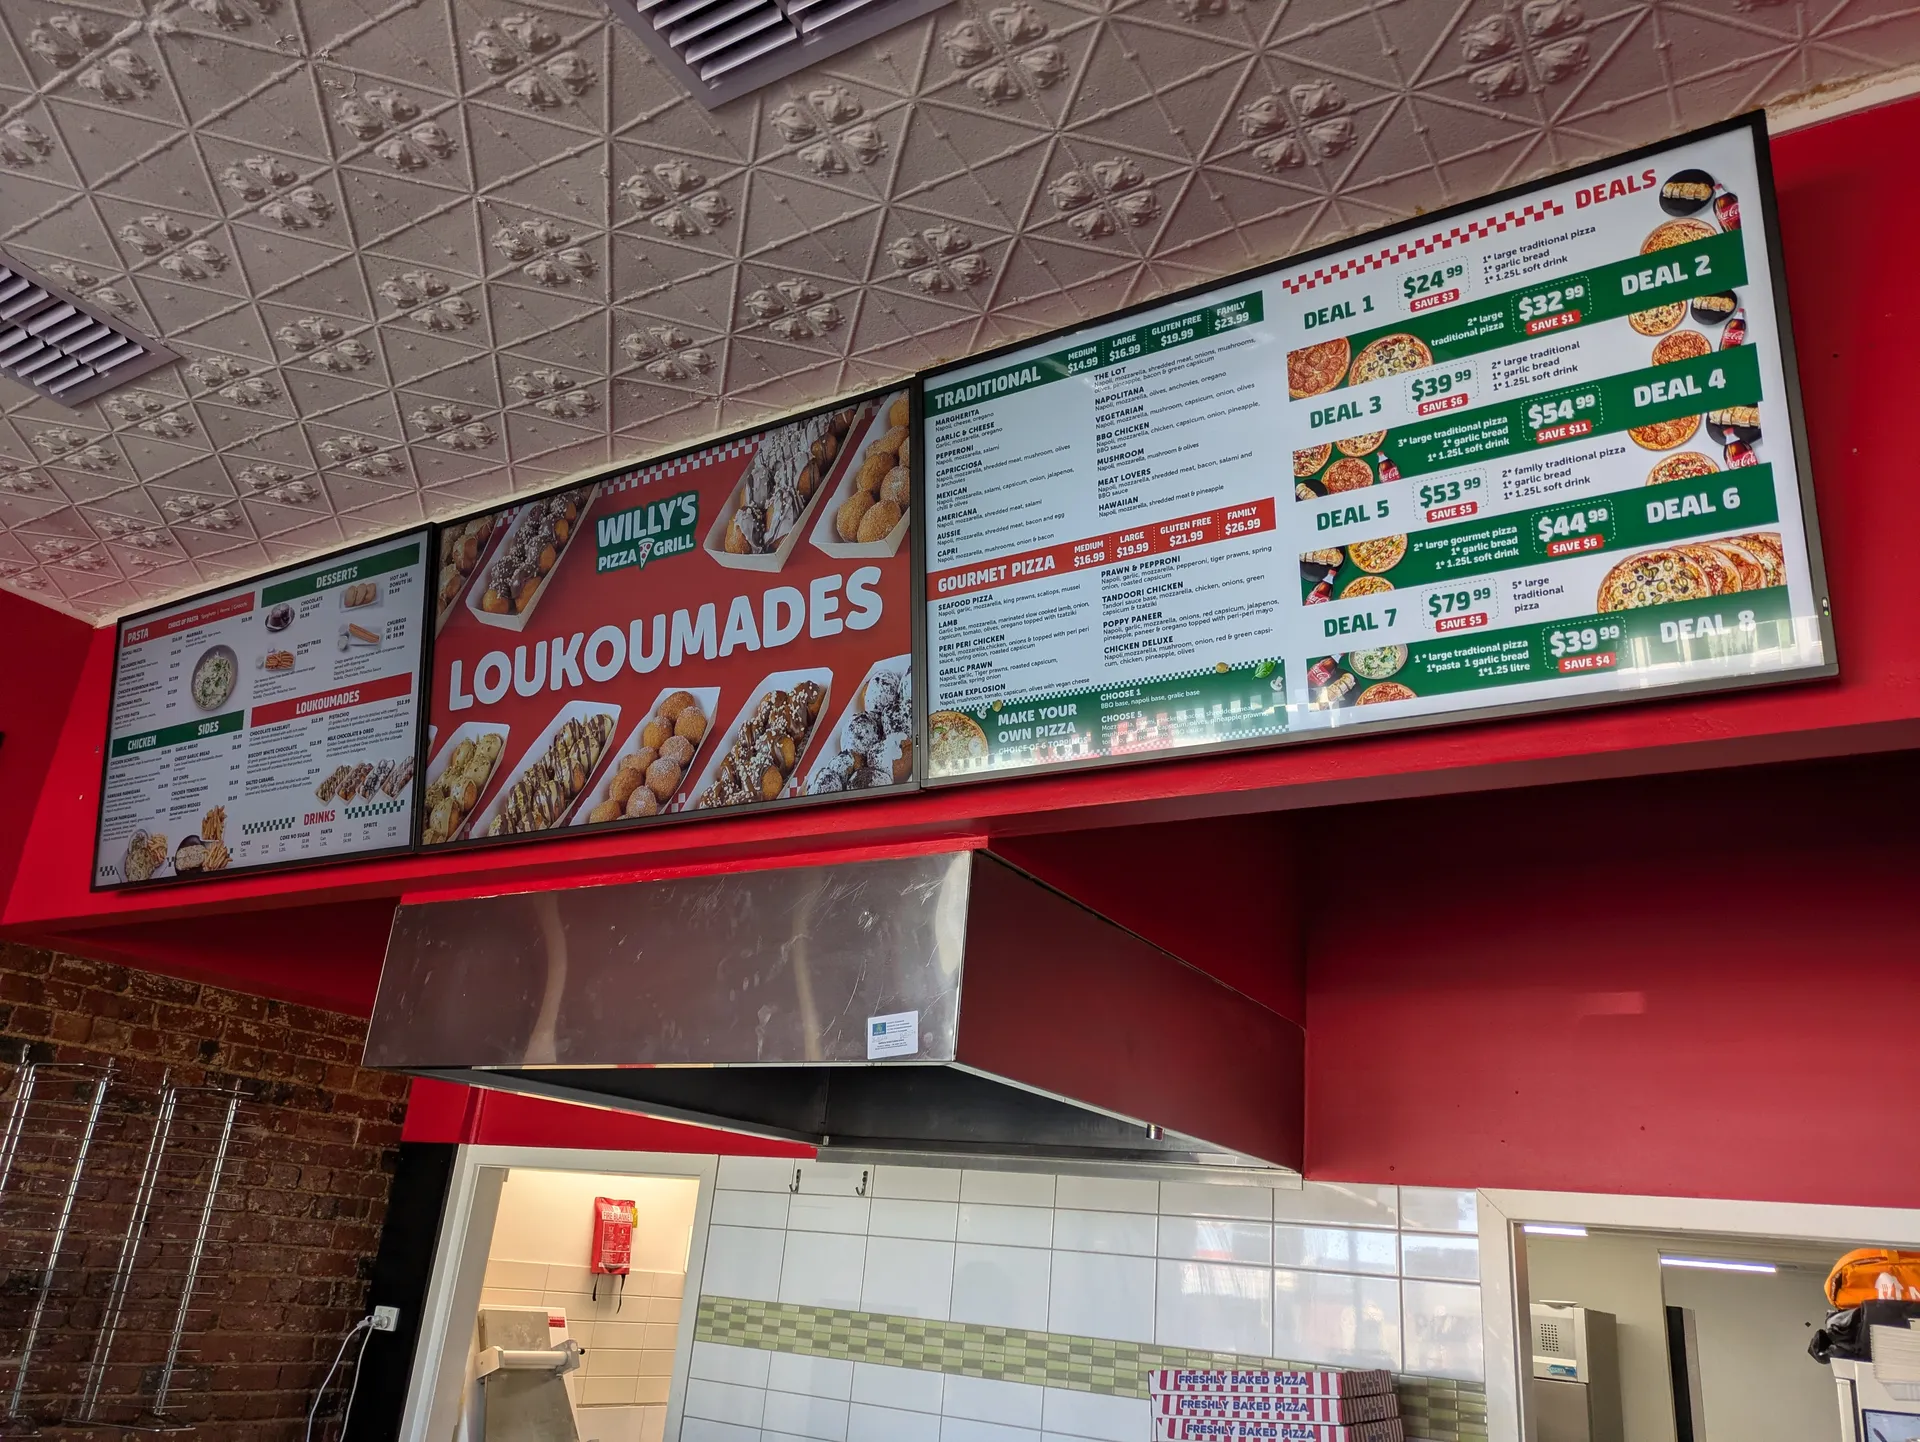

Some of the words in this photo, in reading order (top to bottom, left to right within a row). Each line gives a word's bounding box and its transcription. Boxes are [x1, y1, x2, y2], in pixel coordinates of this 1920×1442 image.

[1575, 170, 1656, 208] DEALS
[1494, 249, 1516, 260] large
[1519, 232, 1568, 252] traditional
[1571, 226, 1595, 239] pizza
[1495, 257, 1520, 272] garlic
[1523, 248, 1549, 263] bread
[1496, 268, 1520, 281] 1.25L
[1523, 263, 1540, 273] soft
[1543, 255, 1567, 267] drink
[1621, 262, 1688, 294] DEAL
[1695, 255, 1711, 276] 2
[1216, 301, 1245, 316] FAMILY
[1415, 296, 1439, 309] SAVE
[1442, 292, 1453, 302] $3
[1304, 301, 1355, 329] DEAL
[1363, 295, 1373, 312] 1
[1479, 311, 1503, 329] large
[1152, 320, 1180, 335] GLUTEN
[1182, 314, 1201, 326] FREE
[1215, 312, 1248, 330] $23.99
[1531, 317, 1558, 331] SAVE
[1561, 314, 1573, 324] $1
[1112, 334, 1136, 347] LARGE
[1161, 328, 1193, 346] $19.99
[1431, 327, 1477, 345] traditional
[1480, 320, 1503, 335] pizza
[1068, 346, 1096, 360] MEDIUM
[1109, 344, 1140, 361] $16.99
[1068, 356, 1097, 374] $14.99
[1094, 371, 1108, 380] THE
[1111, 366, 1126, 376] LOT
[935, 366, 1040, 408] TRADITIONAL
[1095, 386, 1144, 404] NAPOLITANA
[1633, 375, 1701, 406] DEAL
[1708, 368, 1725, 388] 4
[1310, 401, 1362, 428] DEAL
[1369, 395, 1381, 413] 3
[1423, 400, 1447, 412] SAVE
[1451, 396, 1462, 406] $6
[935, 409, 979, 426] MARGHERITA
[1095, 404, 1143, 422] VEGETARIAN
[935, 423, 952, 432] Napoli,
[953, 418, 971, 426] cheese,
[972, 412, 994, 421] oregano
[935, 431, 960, 444] GARLIC
[969, 421, 994, 435] CHEESE
[1096, 431, 1112, 441] BBQ
[1114, 421, 1149, 436] CHICKEN
[1538, 427, 1565, 440] SAVE
[1569, 423, 1587, 434] $11
[936, 444, 973, 459] PEPPERONI
[936, 457, 952, 465] Napoli,
[954, 450, 981, 460] mozzarella,
[983, 444, 999, 453] salami
[1097, 448, 1144, 465] MUSHROOM
[936, 460, 982, 476] CAPRICCIOSA
[936, 486, 966, 499] MEXICAN
[1099, 496, 1138, 510] HAWAIIAN
[1431, 507, 1456, 519] SAVE
[1460, 504, 1471, 516] $5
[1646, 494, 1715, 522] DEAL
[1723, 488, 1740, 508] 6
[598, 494, 696, 547] WILLY'S
[937, 508, 976, 522] AMERICANA
[1227, 506, 1256, 519] FAMILY
[1317, 504, 1370, 530] DEAL
[1377, 499, 1388, 517] 5
[937, 528, 960, 539] AUSSIE
[1160, 521, 1189, 534] GLUTEN
[1192, 516, 1211, 527] FREE
[1225, 518, 1260, 535] $26.99
[1120, 531, 1144, 542] LARGE
[1170, 530, 1202, 546] $21.99
[599, 549, 637, 570] PIZZA
[654, 534, 694, 556] GRILL
[937, 547, 957, 558] CAPRI
[1074, 540, 1103, 552] MEDIUM
[1117, 542, 1148, 557] $19.99
[1553, 540, 1580, 553] SAVE
[1583, 538, 1596, 548] $6
[1074, 552, 1104, 567] $16.99
[1101, 566, 1129, 577] PRAWN
[1140, 555, 1180, 569] PEPPRONI
[316, 566, 357, 587] DESSERTS
[938, 565, 1006, 591] GOURMET
[1012, 555, 1055, 576] PIZZA
[1102, 589, 1144, 602] TANDOORI
[1146, 581, 1182, 594] CHICKEN
[1513, 585, 1563, 600] traditional
[1525, 578, 1548, 590] large
[938, 598, 970, 610] SEAFOOD
[972, 594, 992, 603] PIZZA
[1514, 602, 1538, 613] pizza
[387, 617, 406, 626] CHURROS
[938, 619, 957, 628] LAMB
[1324, 612, 1378, 636] DEAL
[1384, 608, 1396, 626] 7
[1440, 618, 1466, 632] SAVE
[1469, 615, 1481, 625] $5
[1660, 614, 1731, 644] DEAL
[1738, 610, 1756, 632] 8
[127, 628, 148, 642] PASTA
[448, 566, 883, 711] LOUKOUMADES
[939, 643, 953, 651] PERI
[956, 640, 970, 648] PERI
[973, 634, 1004, 645] CHICKEN
[1564, 657, 1592, 669] SAVE
[1596, 655, 1609, 666] $4
[296, 690, 359, 714] LOUKOUMADES
[998, 709, 1034, 725] MAKE
[1038, 703, 1076, 719] YOUR
[198, 720, 218, 735] SIDES
[998, 729, 1031, 743] OWN
[1036, 722, 1076, 737] PIZZA
[128, 735, 156, 750] CHICKEN
[304, 809, 335, 825] DRINKS
[603, 1211, 612, 1220] FIRE
[1179, 1375, 1227, 1384] FRESHLY
[1232, 1376, 1269, 1385] BAKED
[1274, 1376, 1307, 1385] PIZZA
[1181, 1400, 1229, 1410] FRESHLY
[1233, 1402, 1271, 1411] BAKED
[1275, 1403, 1308, 1412] PIZZA
[1187, 1424, 1235, 1435] FRESHLY
[1240, 1427, 1277, 1437] BAKED
[1282, 1429, 1314, 1439] PIZZA
